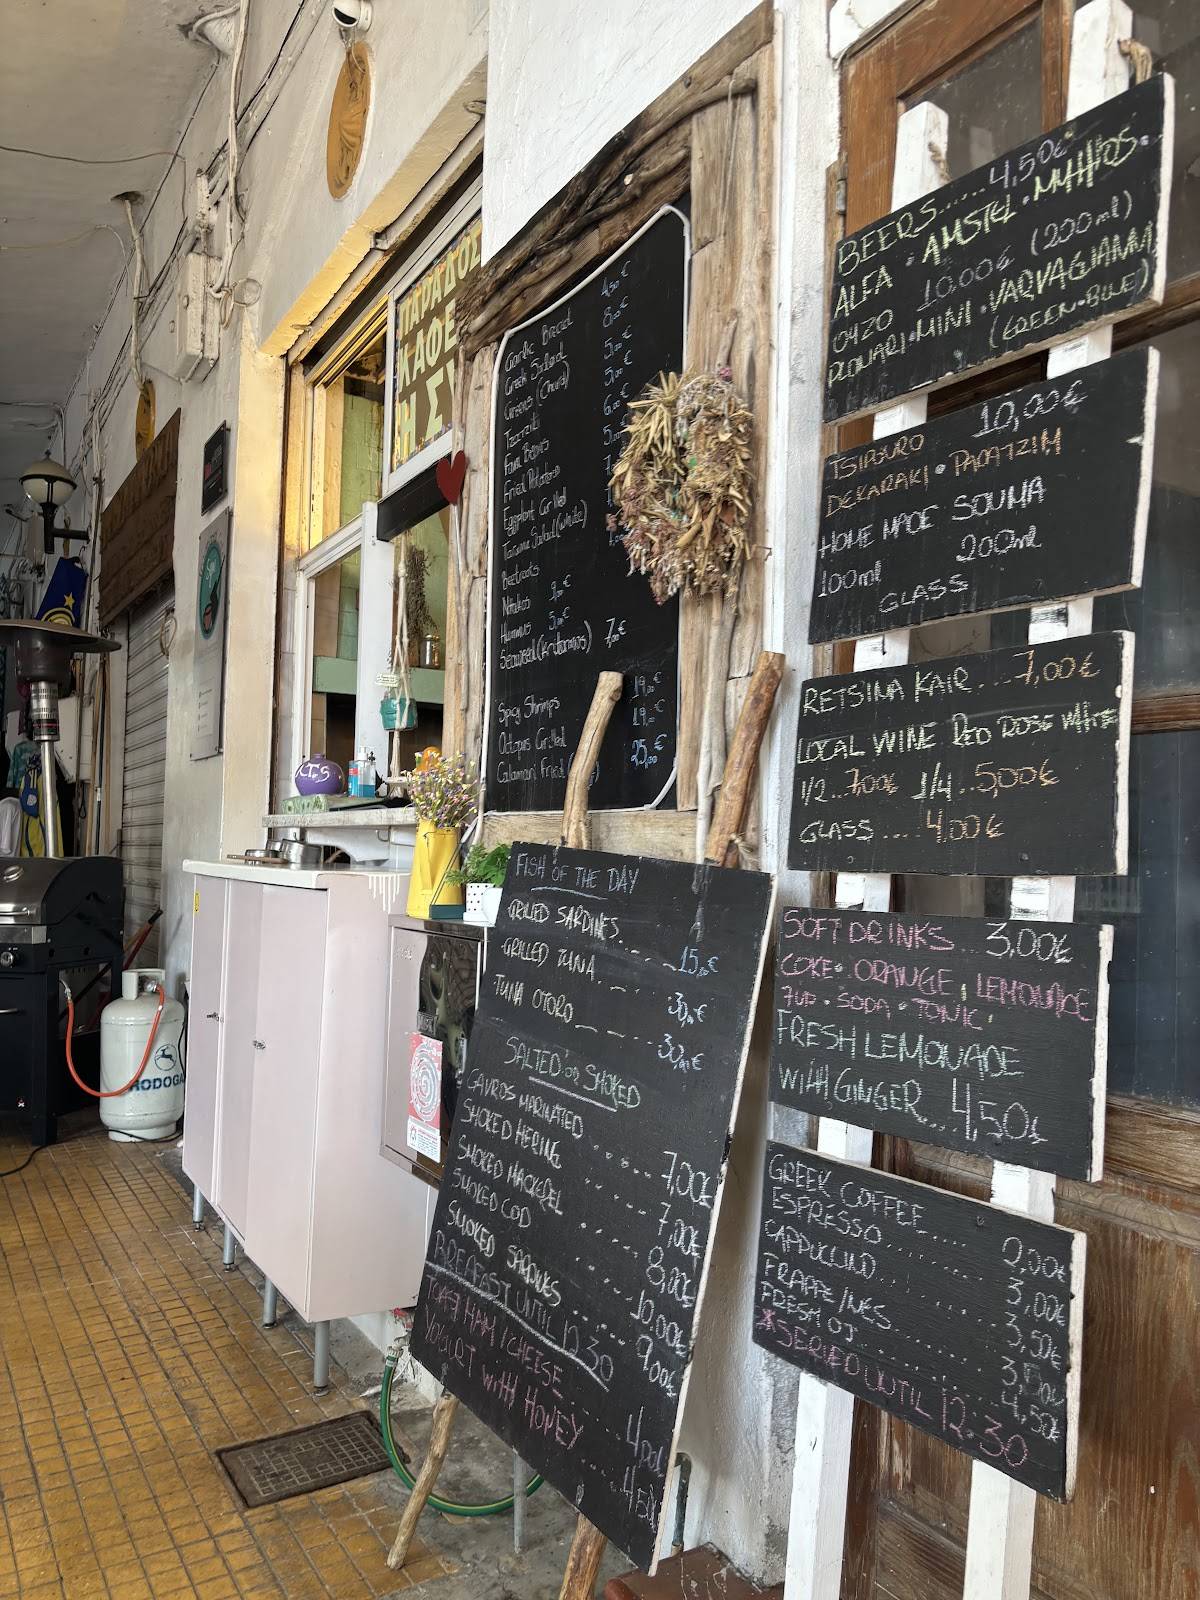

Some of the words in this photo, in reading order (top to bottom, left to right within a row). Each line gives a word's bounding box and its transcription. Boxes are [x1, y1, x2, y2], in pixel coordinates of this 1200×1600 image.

[834, 265, 893, 319] ALFA
[921, 194, 1017, 266] AMSTEL
[838, 198, 937, 276] BEERS
[819, 524, 875, 559] HOME
[883, 504, 939, 540] MADE
[952, 475, 1047, 521] SOUMA
[955, 525, 1042, 562] 200ml
[879, 573, 969, 613] GLASS
[802, 678, 905, 717] RETSINA
[797, 734, 866, 764] LOCAL
[872, 721, 938, 756] WINE
[801, 776, 828, 806] 1/2
[911, 761, 952, 801] 1/4
[799, 818, 874, 844] GLASS
[516, 852, 546, 879] FISH
[552, 865, 567, 883] OF
[575, 866, 600, 889] THE
[608, 864, 640, 894] DAY
[555, 904, 620, 940] SARDINES
[784, 909, 841, 944] SOFT
[849, 919, 955, 951] DRINKS
[501, 937, 550, 968] GRILLED
[557, 949, 600, 982] TUNA
[780, 952, 833, 980] COKE
[854, 958, 953, 995] ORANGE
[494, 974, 524, 1006] TUNA
[532, 989, 574, 1024] OTORO
[836, 992, 891, 1020] SODA
[776, 1008, 857, 1060] FRESH
[864, 1031, 1025, 1081] LEMONADE
[467, 1068, 516, 1101] GAVROS
[504, 1036, 561, 1076] SALTED
[582, 1064, 641, 1109] SMOKED
[833, 1067, 927, 1124] GINGER
[460, 1098, 512, 1140] SMOKED
[458, 1134, 504, 1180] SMOKED
[451, 1167, 498, 1212] SMOKED
[501, 1198, 532, 1228] COD
[768, 1153, 832, 1198] GREEK
[840, 1181, 928, 1234] COFFEE
[772, 1186, 881, 1244] ESPRESSO
[447, 1199, 496, 1258] SMOKED
[761, 1280, 822, 1327] FRESH
[524, 1385, 584, 1450] HONEY
